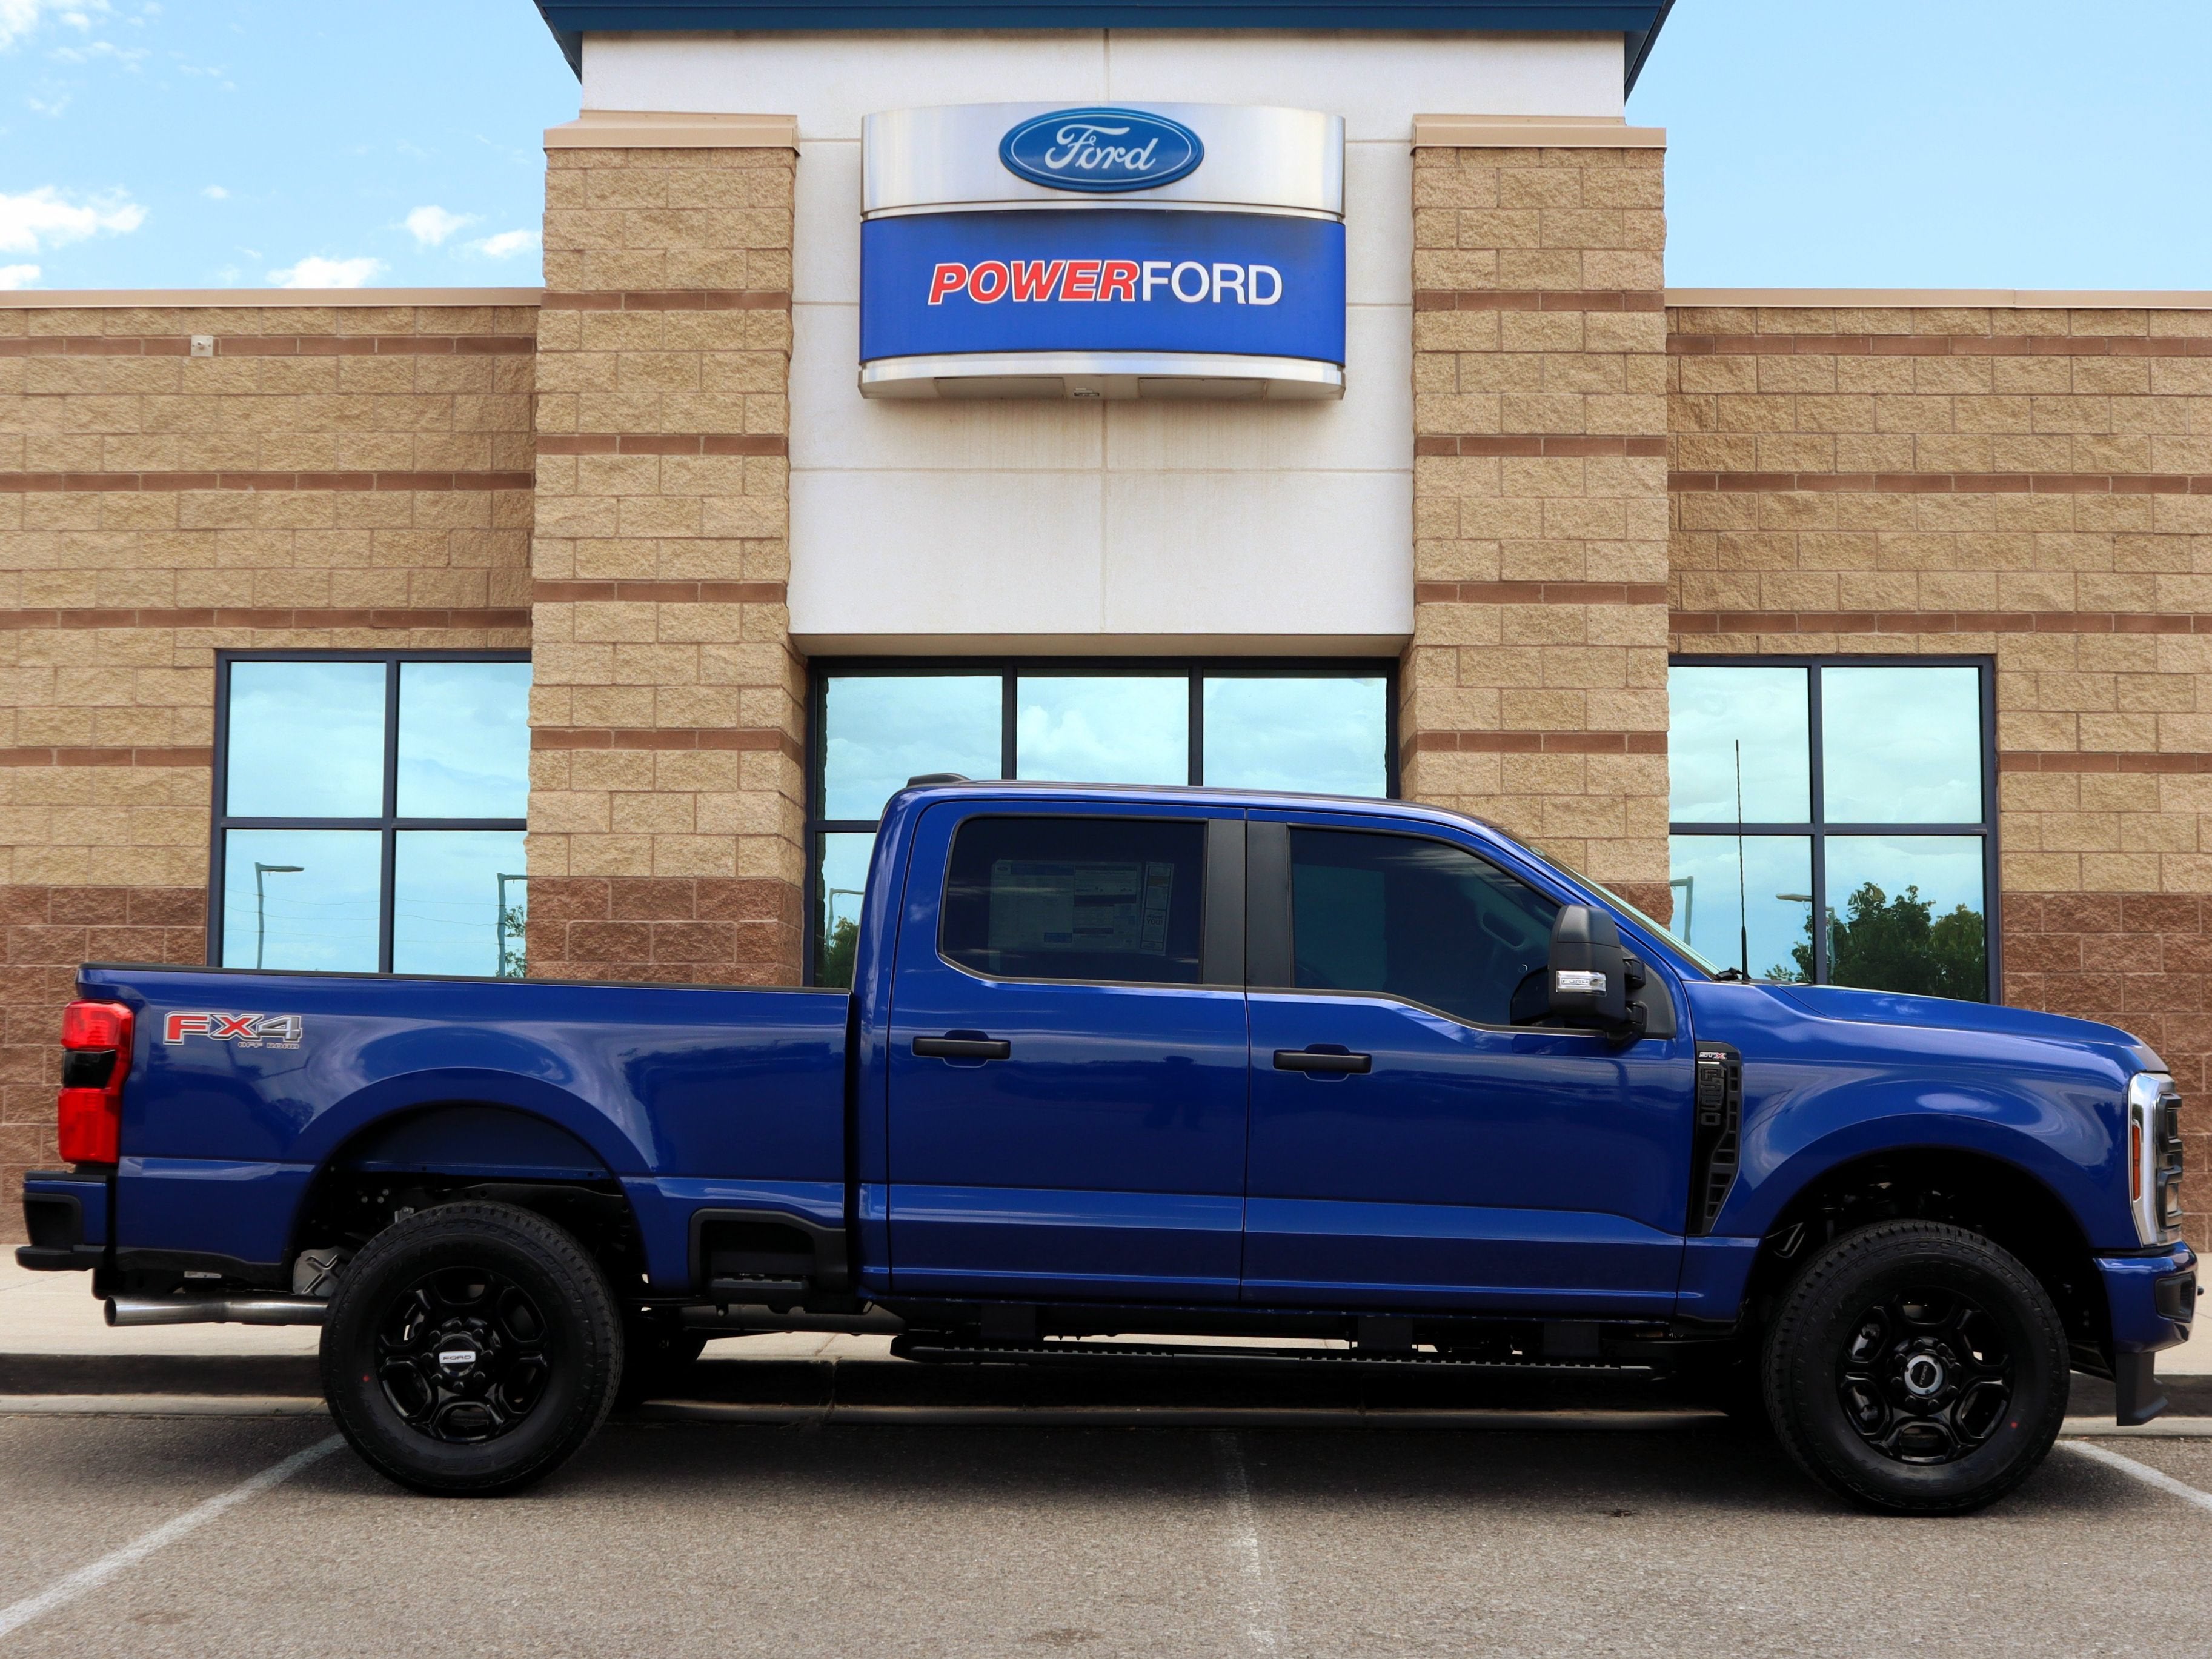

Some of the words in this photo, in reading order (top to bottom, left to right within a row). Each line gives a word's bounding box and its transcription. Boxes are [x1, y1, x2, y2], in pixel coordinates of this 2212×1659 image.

[1045, 124, 1159, 170] Ford
[163, 1011, 302, 1045] FX4
[1699, 1051, 1727, 1060] STX
